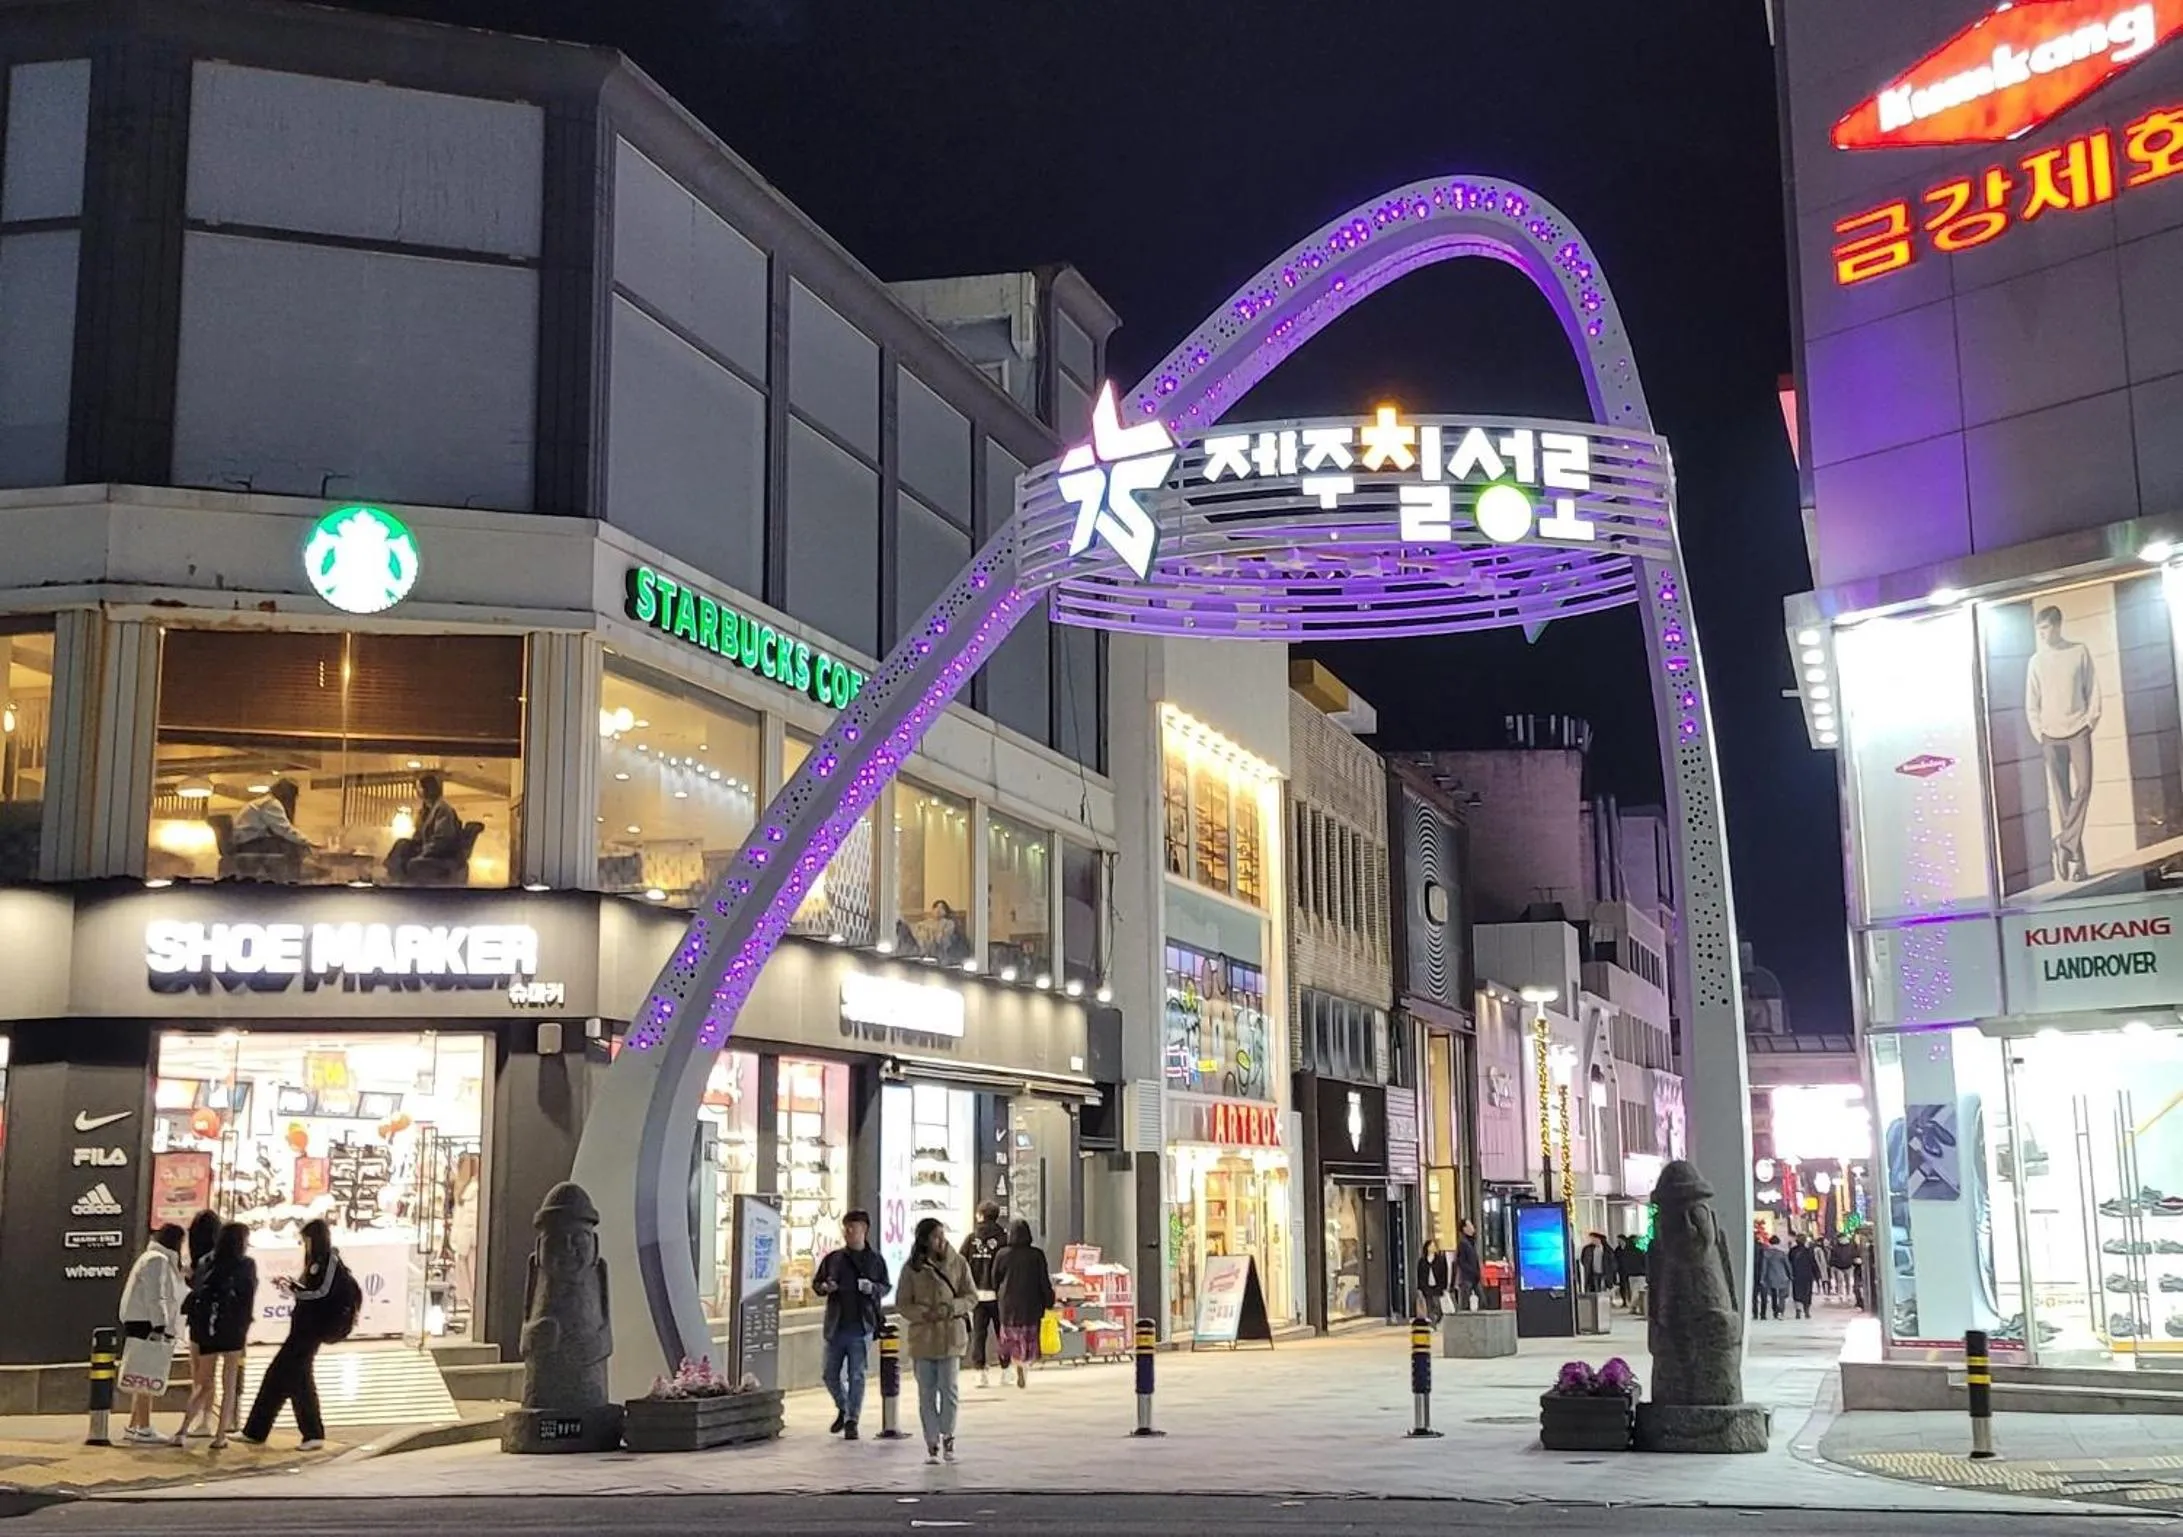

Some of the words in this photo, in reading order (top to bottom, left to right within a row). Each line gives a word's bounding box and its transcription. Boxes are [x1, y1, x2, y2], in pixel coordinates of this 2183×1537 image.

[634, 566, 810, 692] STARBUCKS
[146, 920, 303, 973] SHOE
[311, 923, 538, 974] MARKER
[2025, 916, 2171, 947] KUMKANG
[2044, 951, 2157, 981] LANDROVER
[1215, 1102, 1282, 1146] ARTBOX
[73, 1147, 127, 1166] FILA
[65, 1264, 119, 1278] whever
